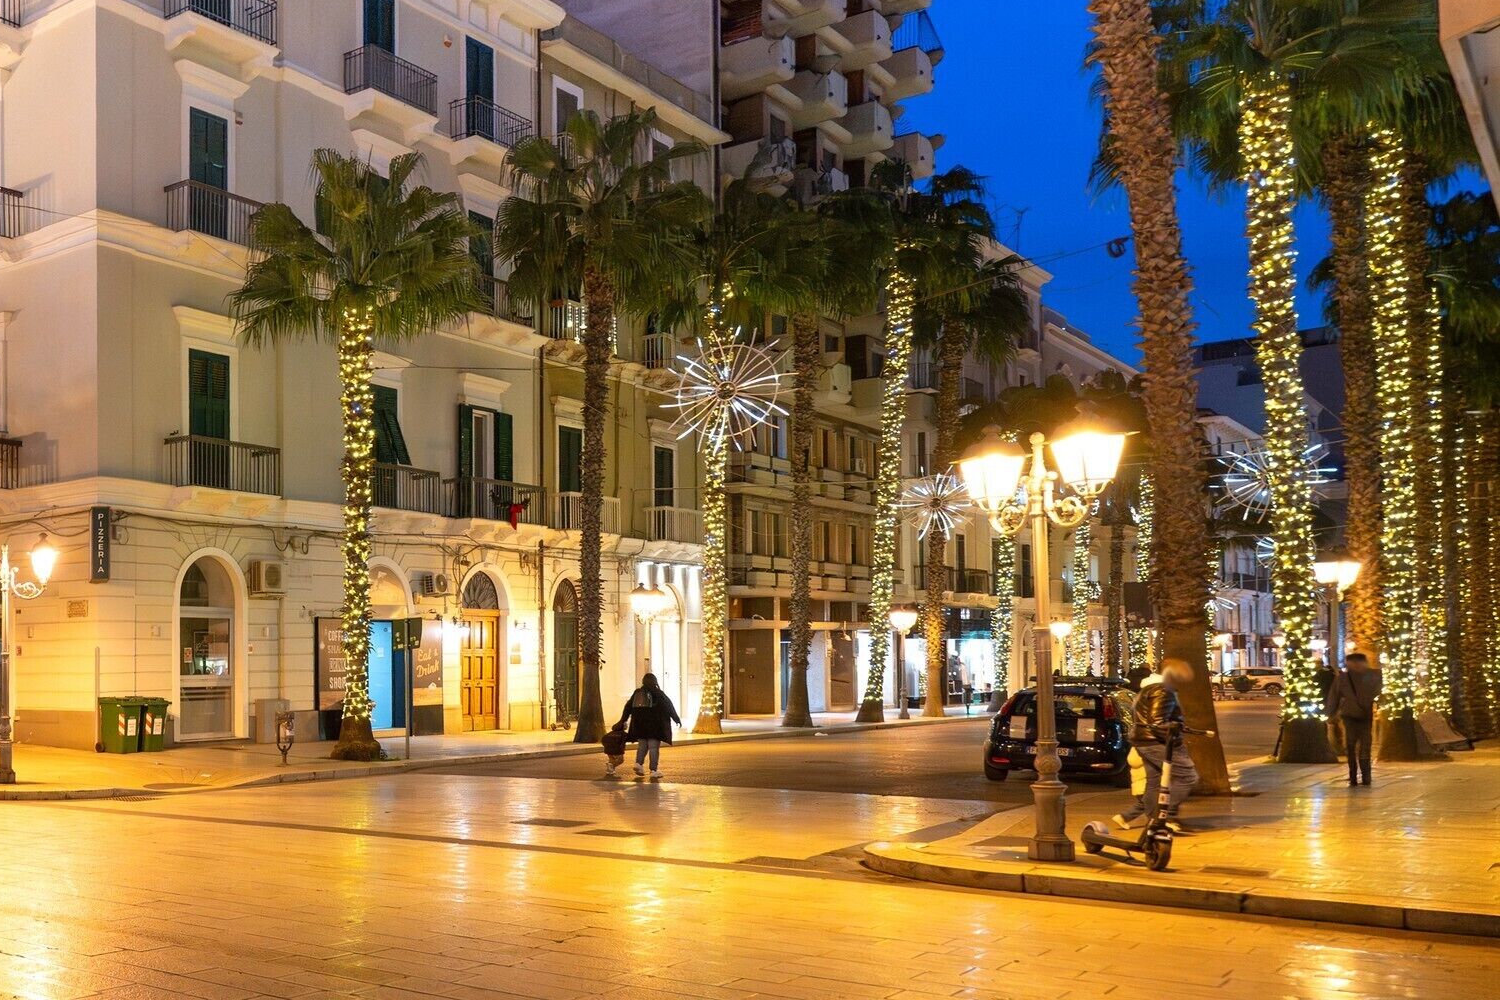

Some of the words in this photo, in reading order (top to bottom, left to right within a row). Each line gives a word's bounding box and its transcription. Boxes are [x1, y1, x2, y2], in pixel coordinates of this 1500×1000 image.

[97, 513, 105, 573] PIZZERIA
[417, 649, 432, 662] Eat
[416, 659, 440, 678] Drink
